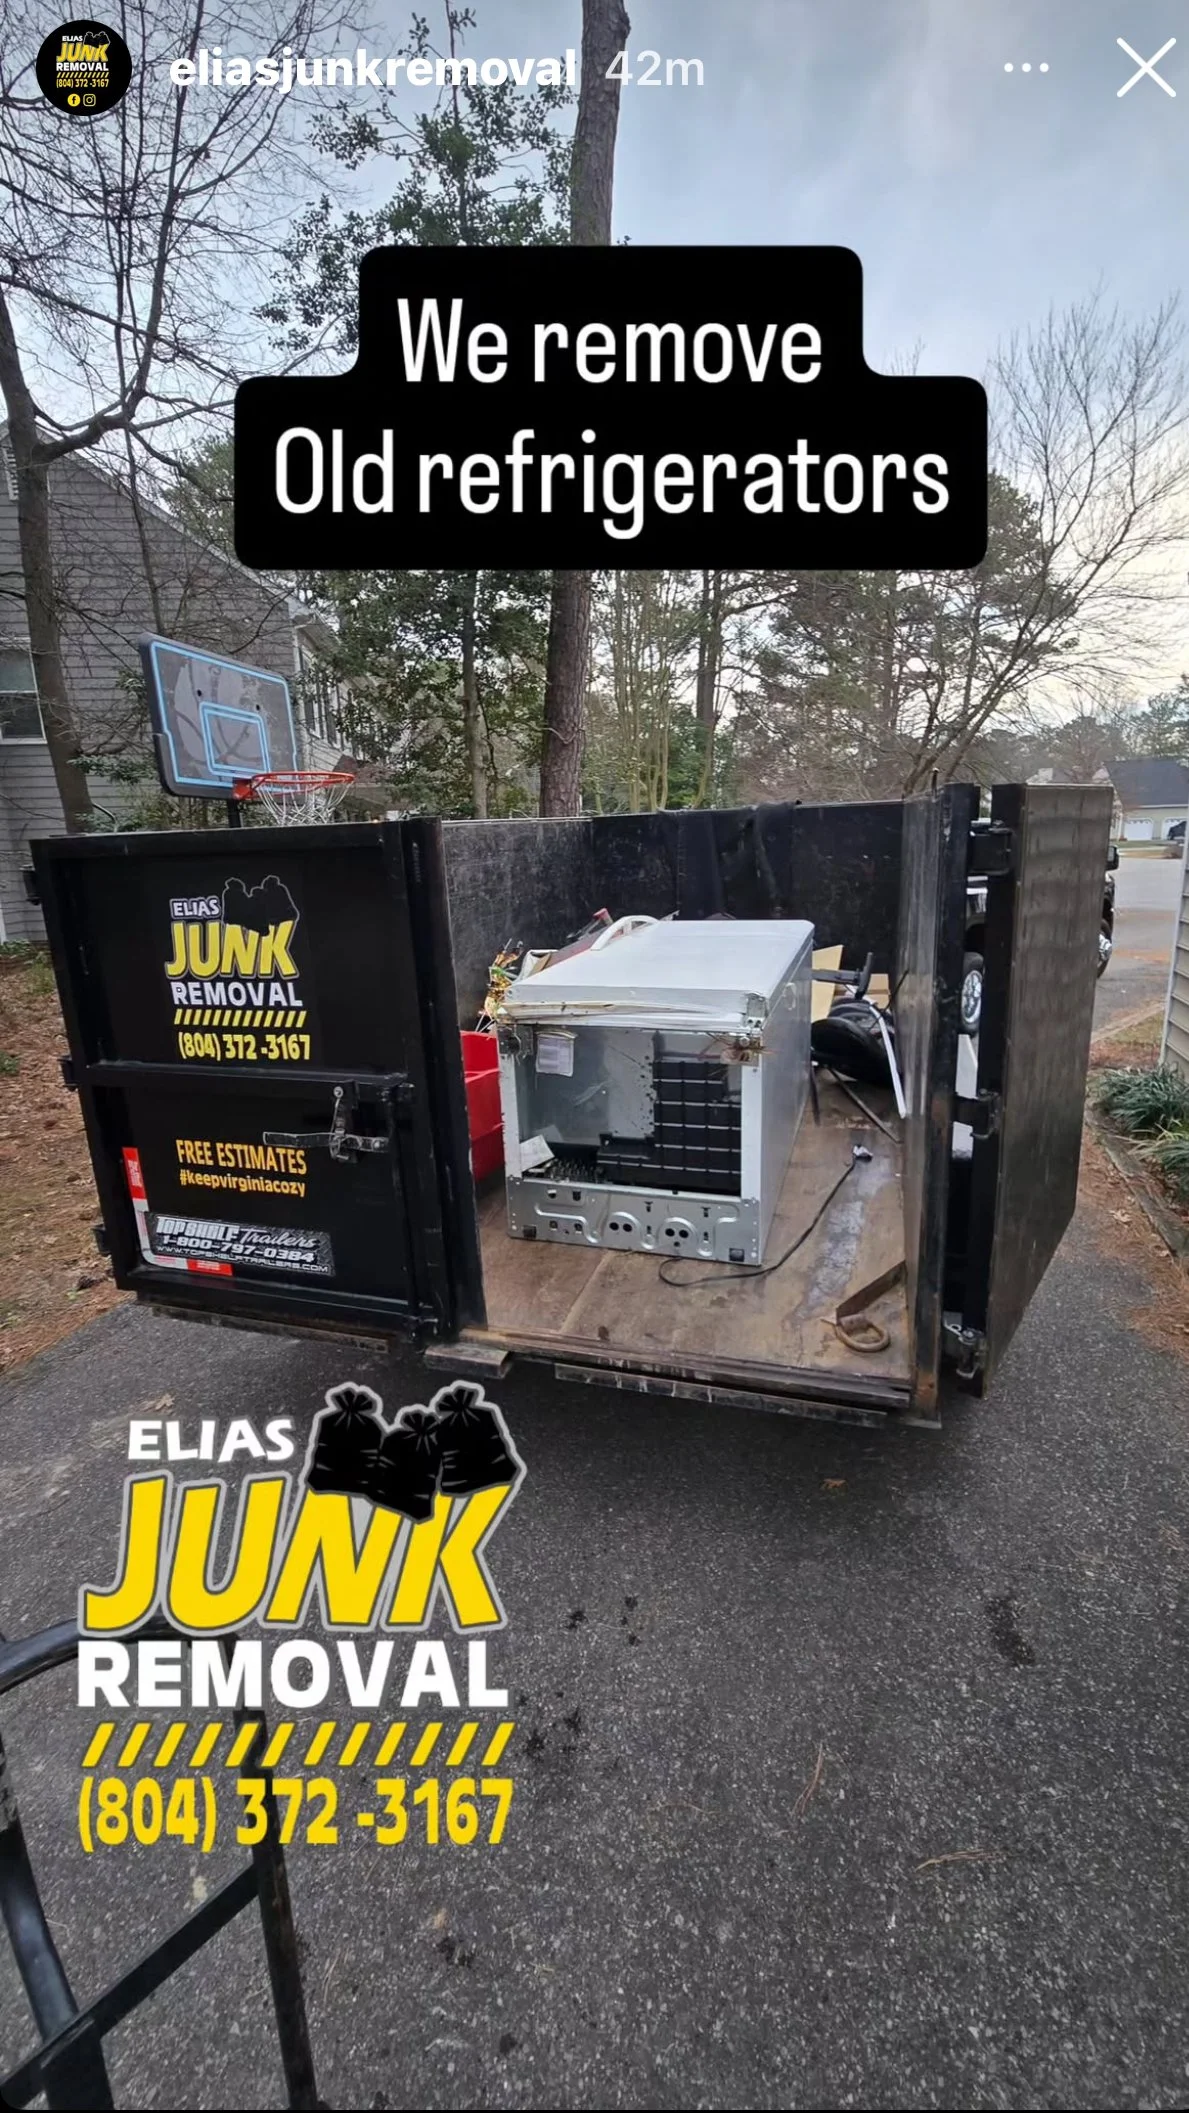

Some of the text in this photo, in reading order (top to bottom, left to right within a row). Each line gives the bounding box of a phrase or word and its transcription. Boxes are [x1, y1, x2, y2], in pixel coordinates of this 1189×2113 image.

[172, 899, 220, 917] ELIAS
[166, 920, 298, 977] JUNK
[170, 981, 303, 1007] REMOVAL
[178, 1031, 311, 1061] (804) 372 -3167
[176, 1139, 308, 1176] FREE ESTIMATES
[179, 1168, 306, 1198] #keepvirginiacozy
[162, 1235, 315, 1263] 1-800-797-0384
[239, 1227, 317, 1249] Trailers
